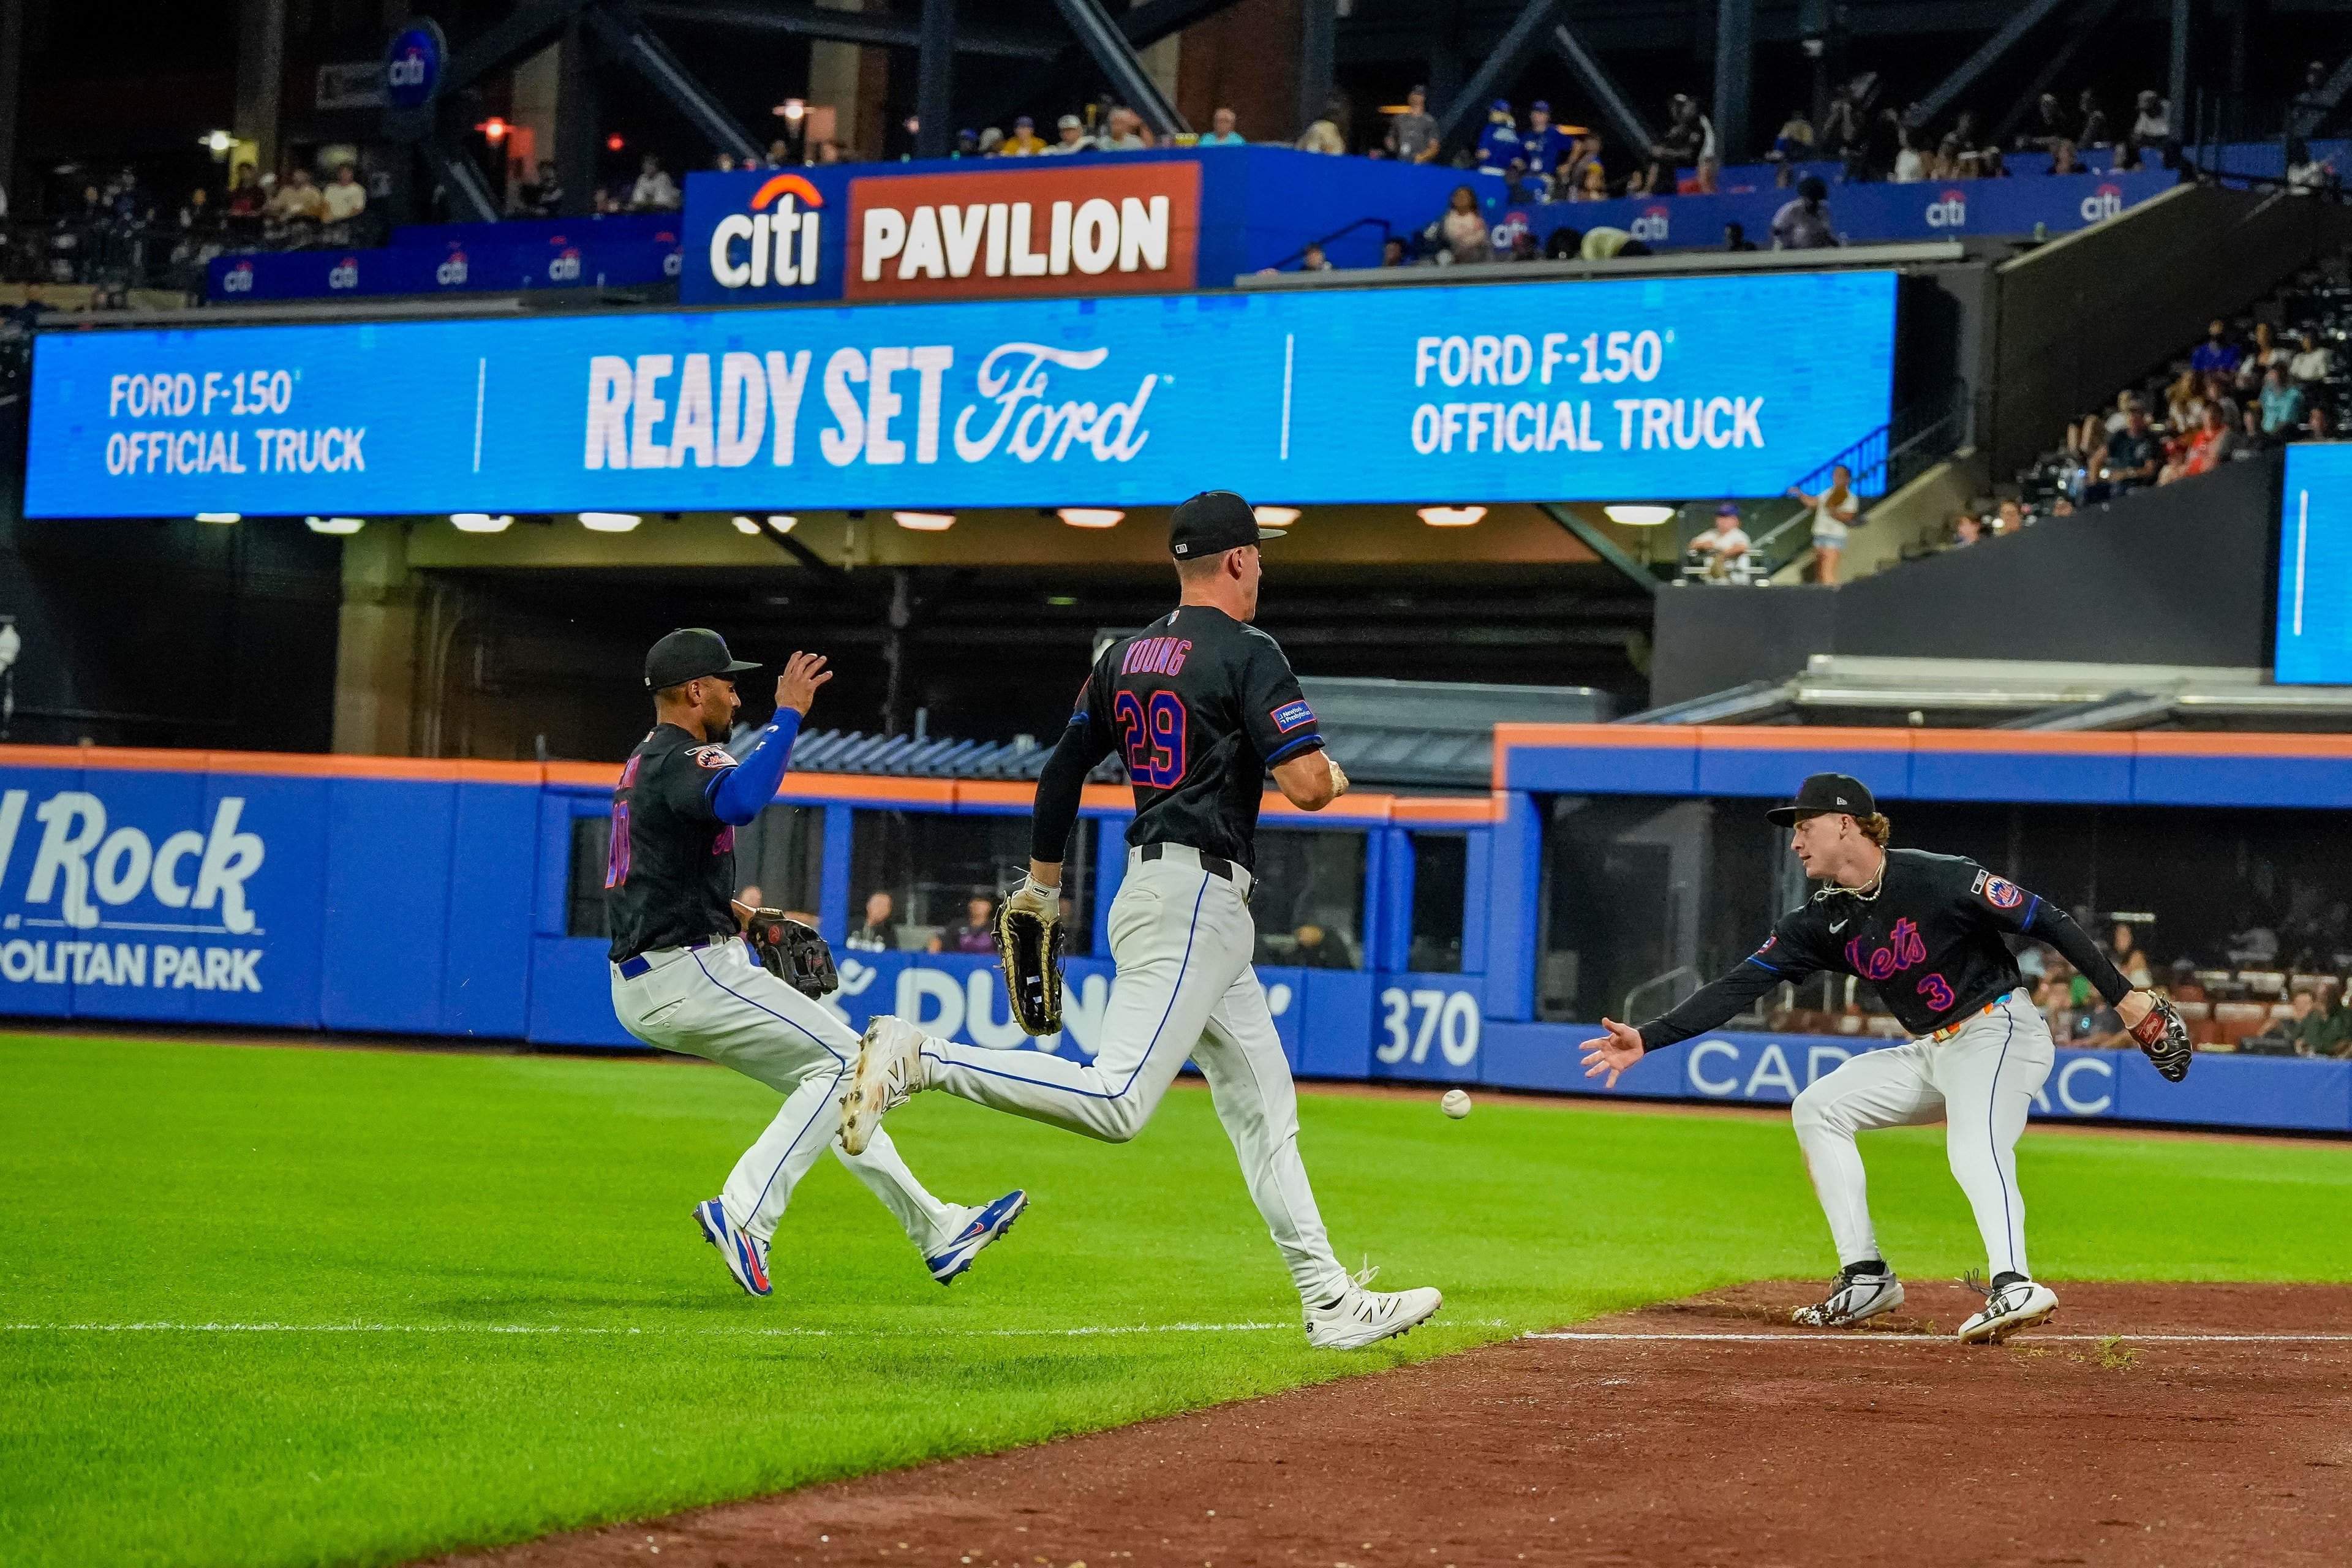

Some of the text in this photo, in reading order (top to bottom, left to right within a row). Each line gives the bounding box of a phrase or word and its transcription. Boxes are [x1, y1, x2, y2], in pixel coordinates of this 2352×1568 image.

[710, 192, 820, 288] citi
[861, 195, 1170, 282] PAVILION
[1415, 330, 1663, 387] FORD F-150
[109, 370, 293, 418] FORD F-150
[584, 341, 1160, 470] READY SET Ford
[106, 427, 367, 476] OFFICIAL TRUCK
[1411, 396, 1766, 454] OFFICIAL TRUCK
[1121, 637, 1193, 677] YOUNG
[1114, 690, 1186, 790] 29
[24, 790, 266, 935] Rock
[0, 938, 264, 993] OLITAN PARK
[1916, 973, 1956, 1012] 3
[1376, 987, 1481, 1067] 370
